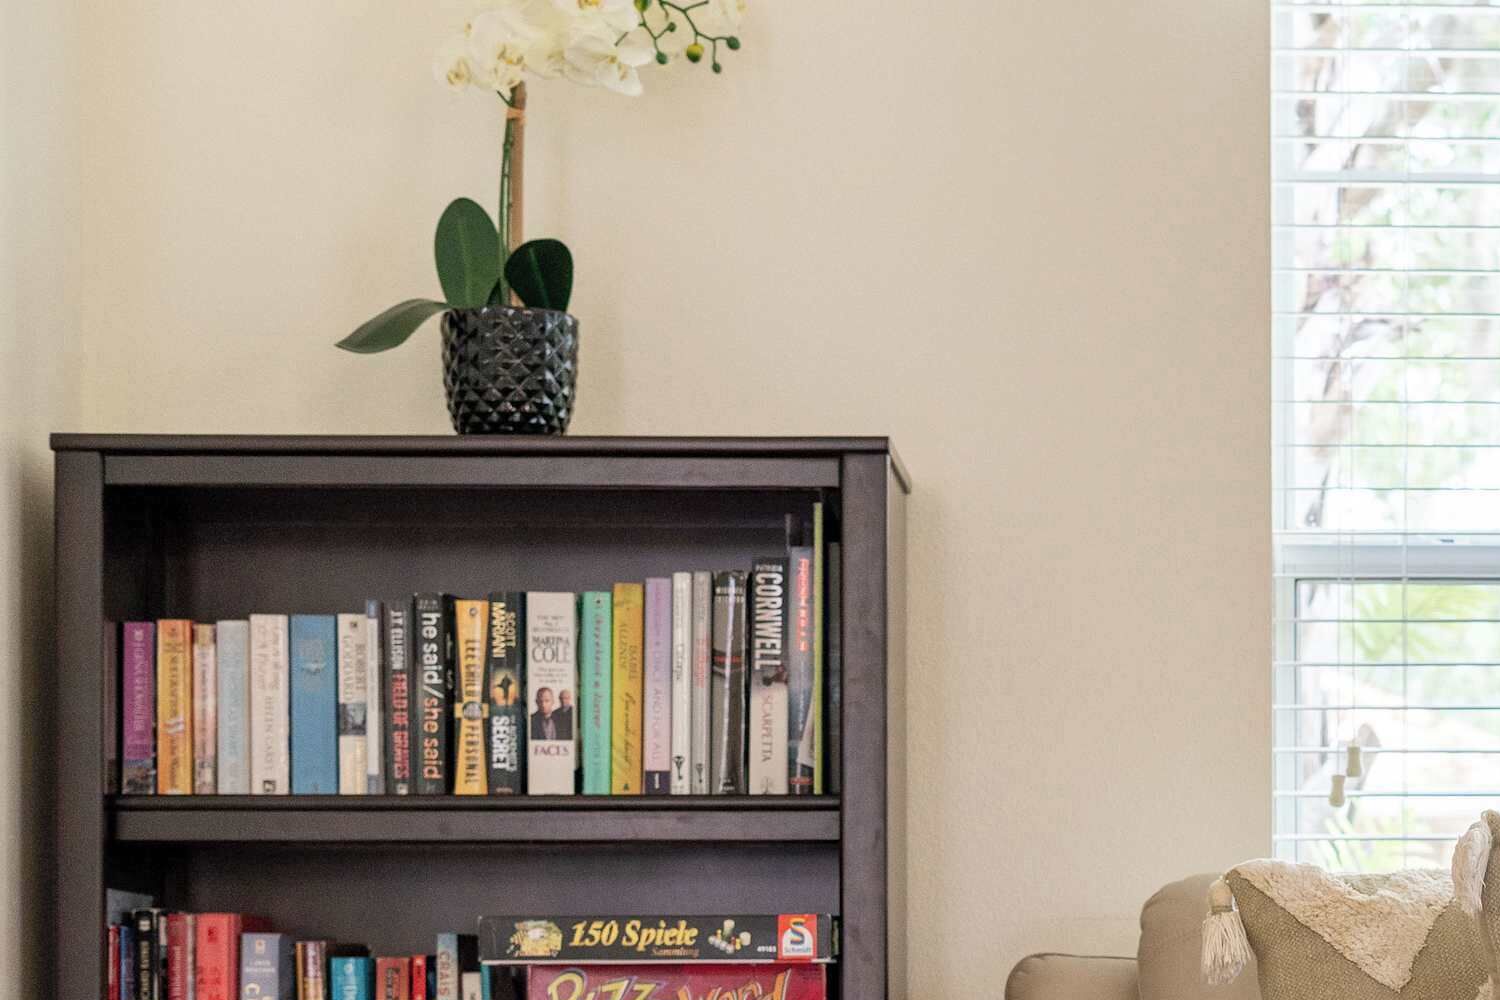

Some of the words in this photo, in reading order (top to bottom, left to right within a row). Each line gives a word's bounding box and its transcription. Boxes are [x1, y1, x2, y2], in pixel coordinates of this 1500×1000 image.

[422, 612, 441, 639] he
[492, 602, 506, 658] MARIANI
[505, 612, 516, 648] SCOTT
[754, 573, 784, 671] CORNWELL
[391, 628, 405, 670] ELLISON
[464, 638, 480, 660] LEE
[532, 635, 570, 647] MARTINA
[532, 646, 570, 663] COLE
[392, 672, 408, 709] FIELD
[464, 663, 480, 698] CHILD
[652, 687, 662, 714] AND
[392, 710, 409, 727] OF
[760, 693, 774, 763] SCARPETTA
[392, 730, 410, 779] GRAVES
[422, 737, 443, 780] said
[464, 724, 480, 785] PERSONAL
[492, 716, 510, 770] SECRET
[534, 745, 569, 757] FACES
[652, 744, 662, 761] ALL
[570, 919, 618, 946] 150
[622, 918, 699, 952] Spiele
[783, 945, 811, 954] Schmidt
[438, 950, 450, 996] CRAIS
